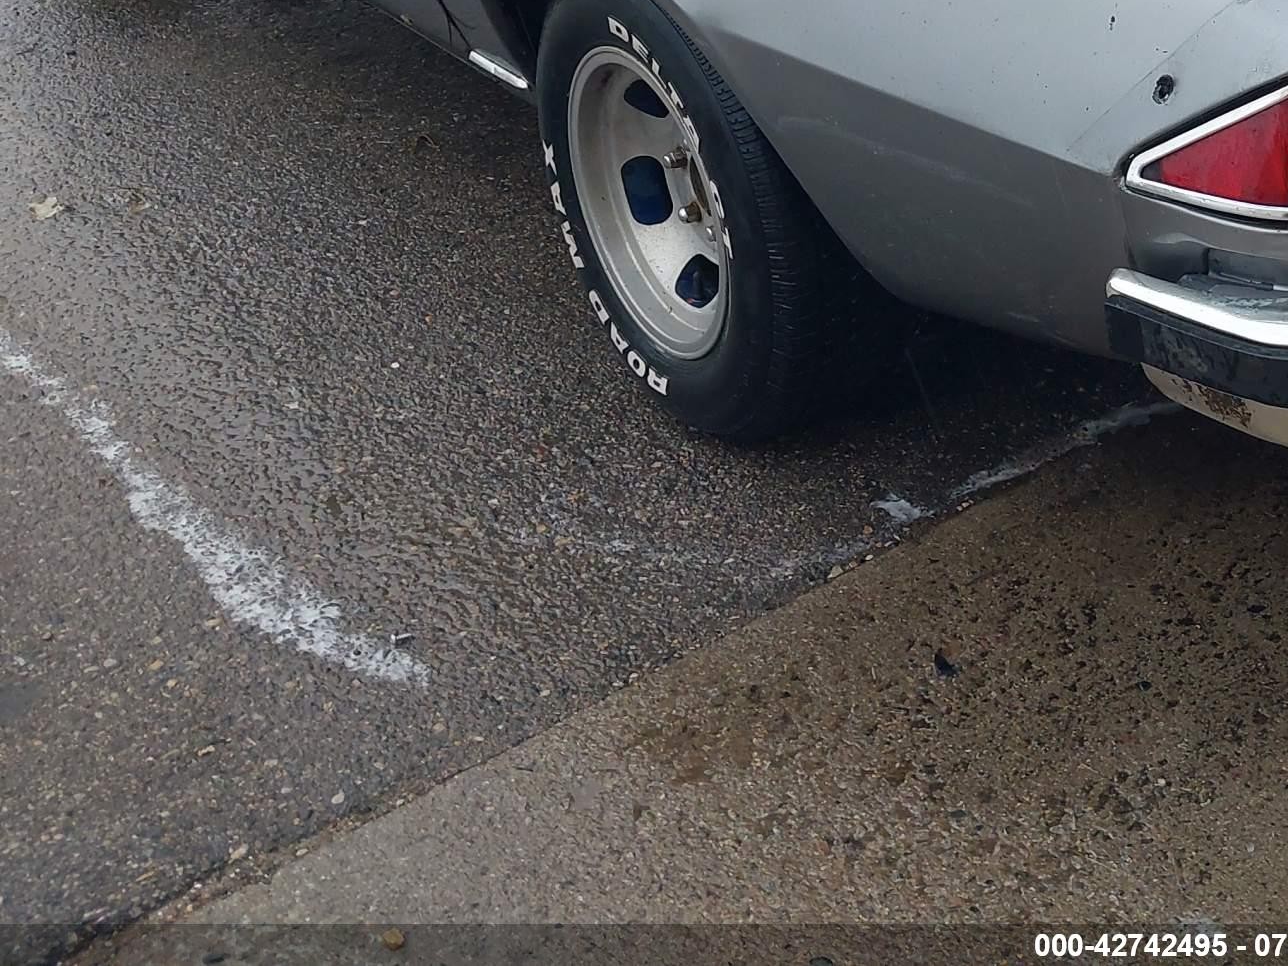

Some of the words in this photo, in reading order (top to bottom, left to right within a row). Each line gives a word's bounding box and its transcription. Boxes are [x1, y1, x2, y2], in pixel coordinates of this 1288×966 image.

[607, 16, 701, 155] DELTA
[541, 139, 585, 269] MAX
[588, 289, 670, 397] ROAD
